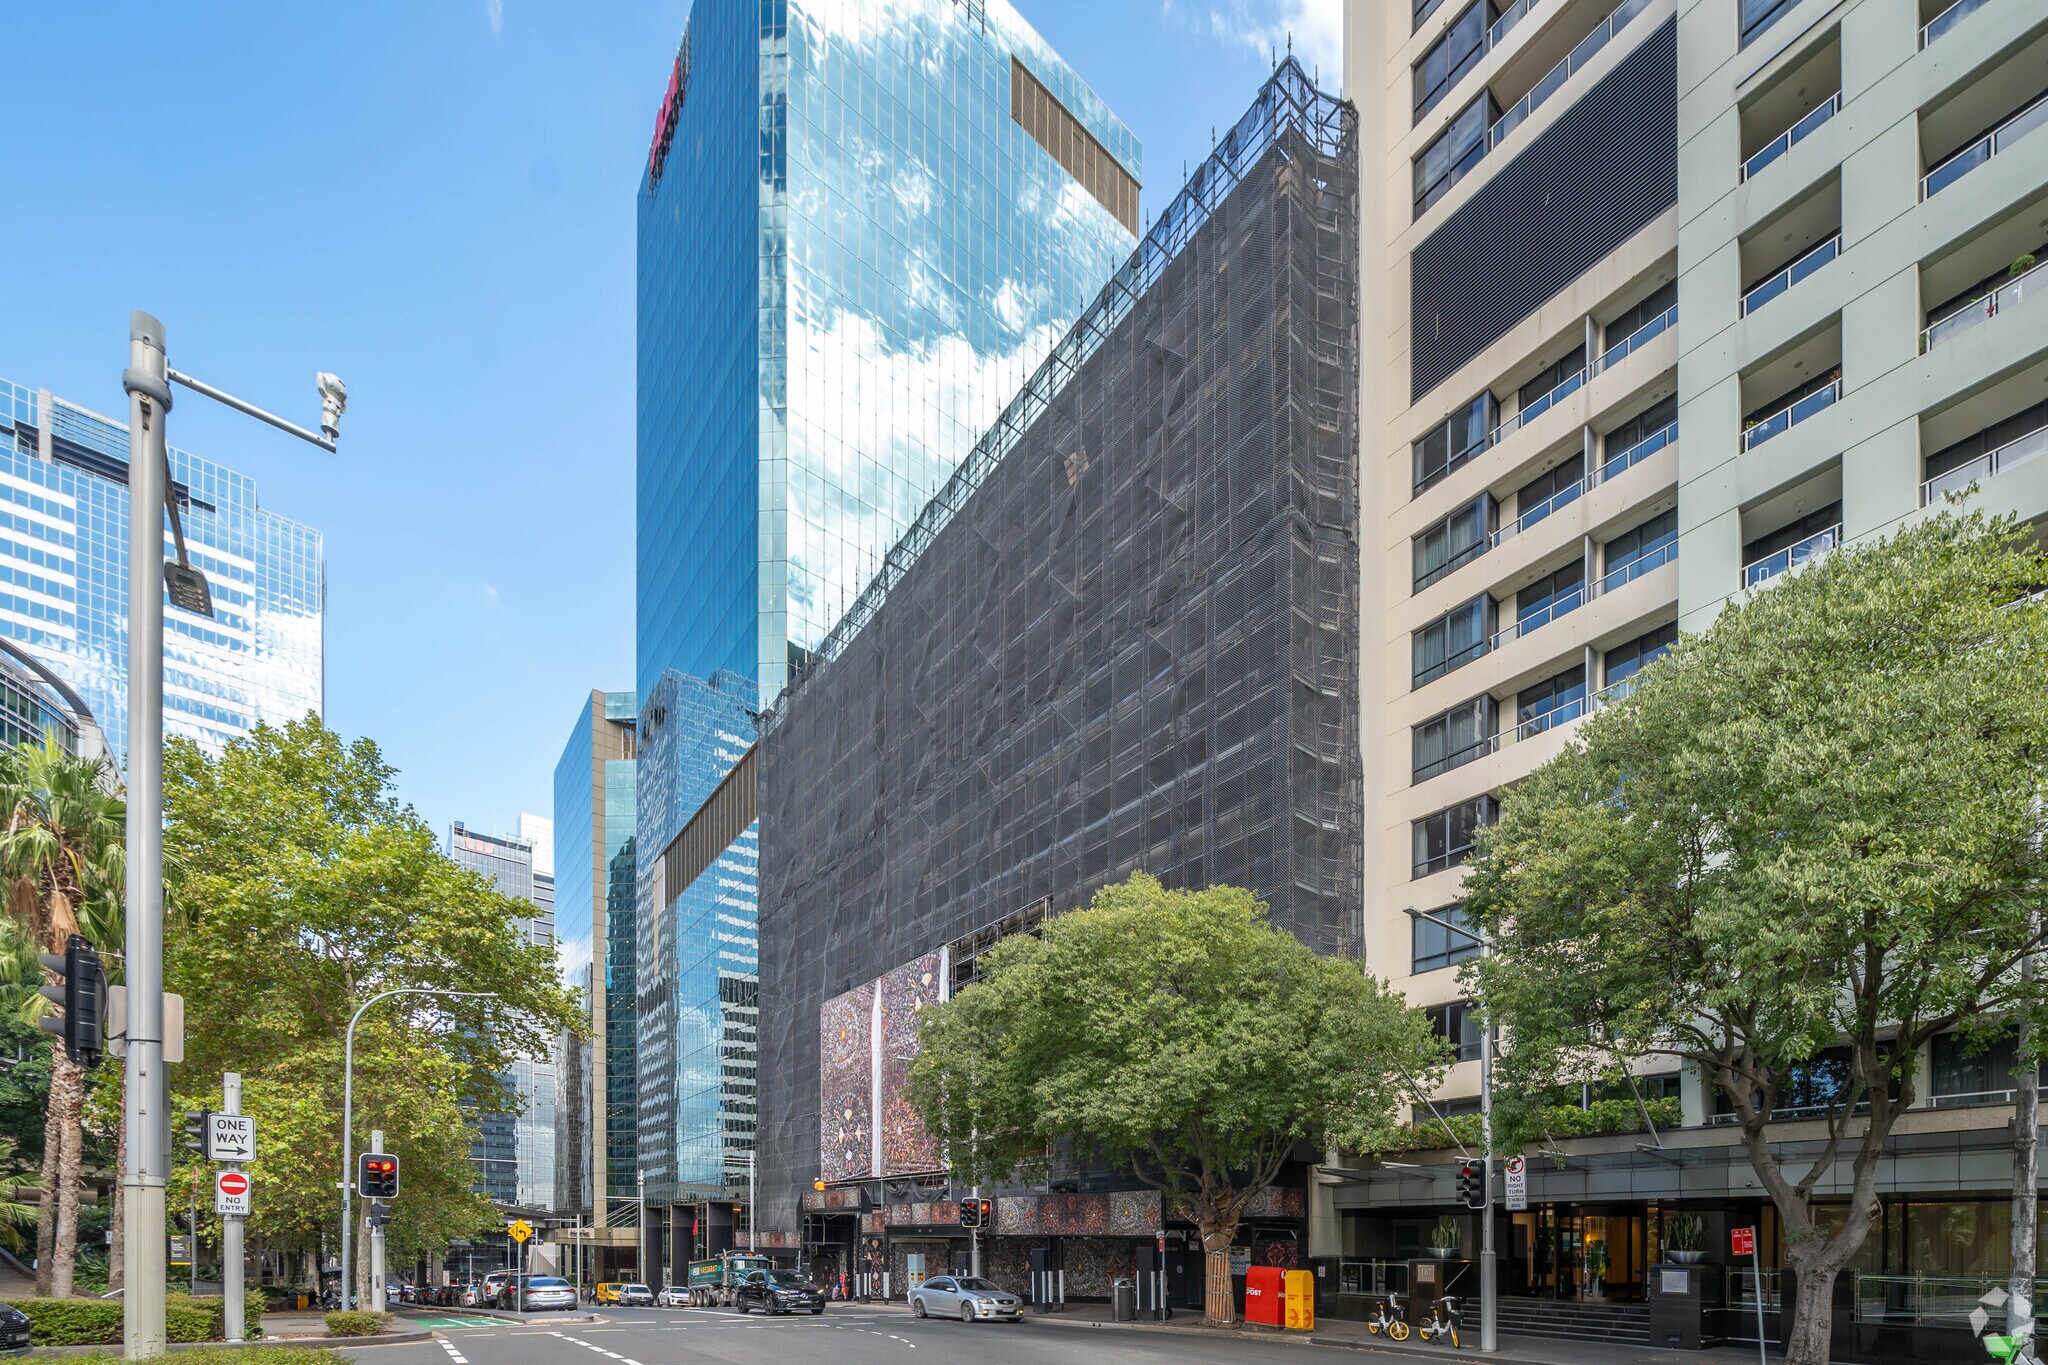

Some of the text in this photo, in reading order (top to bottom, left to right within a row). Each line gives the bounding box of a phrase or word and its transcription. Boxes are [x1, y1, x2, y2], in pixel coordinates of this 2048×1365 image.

[217, 1120, 247, 1130] ONE
[216, 1133, 248, 1144] WAY
[1421, 1268, 1431, 1276] 187
